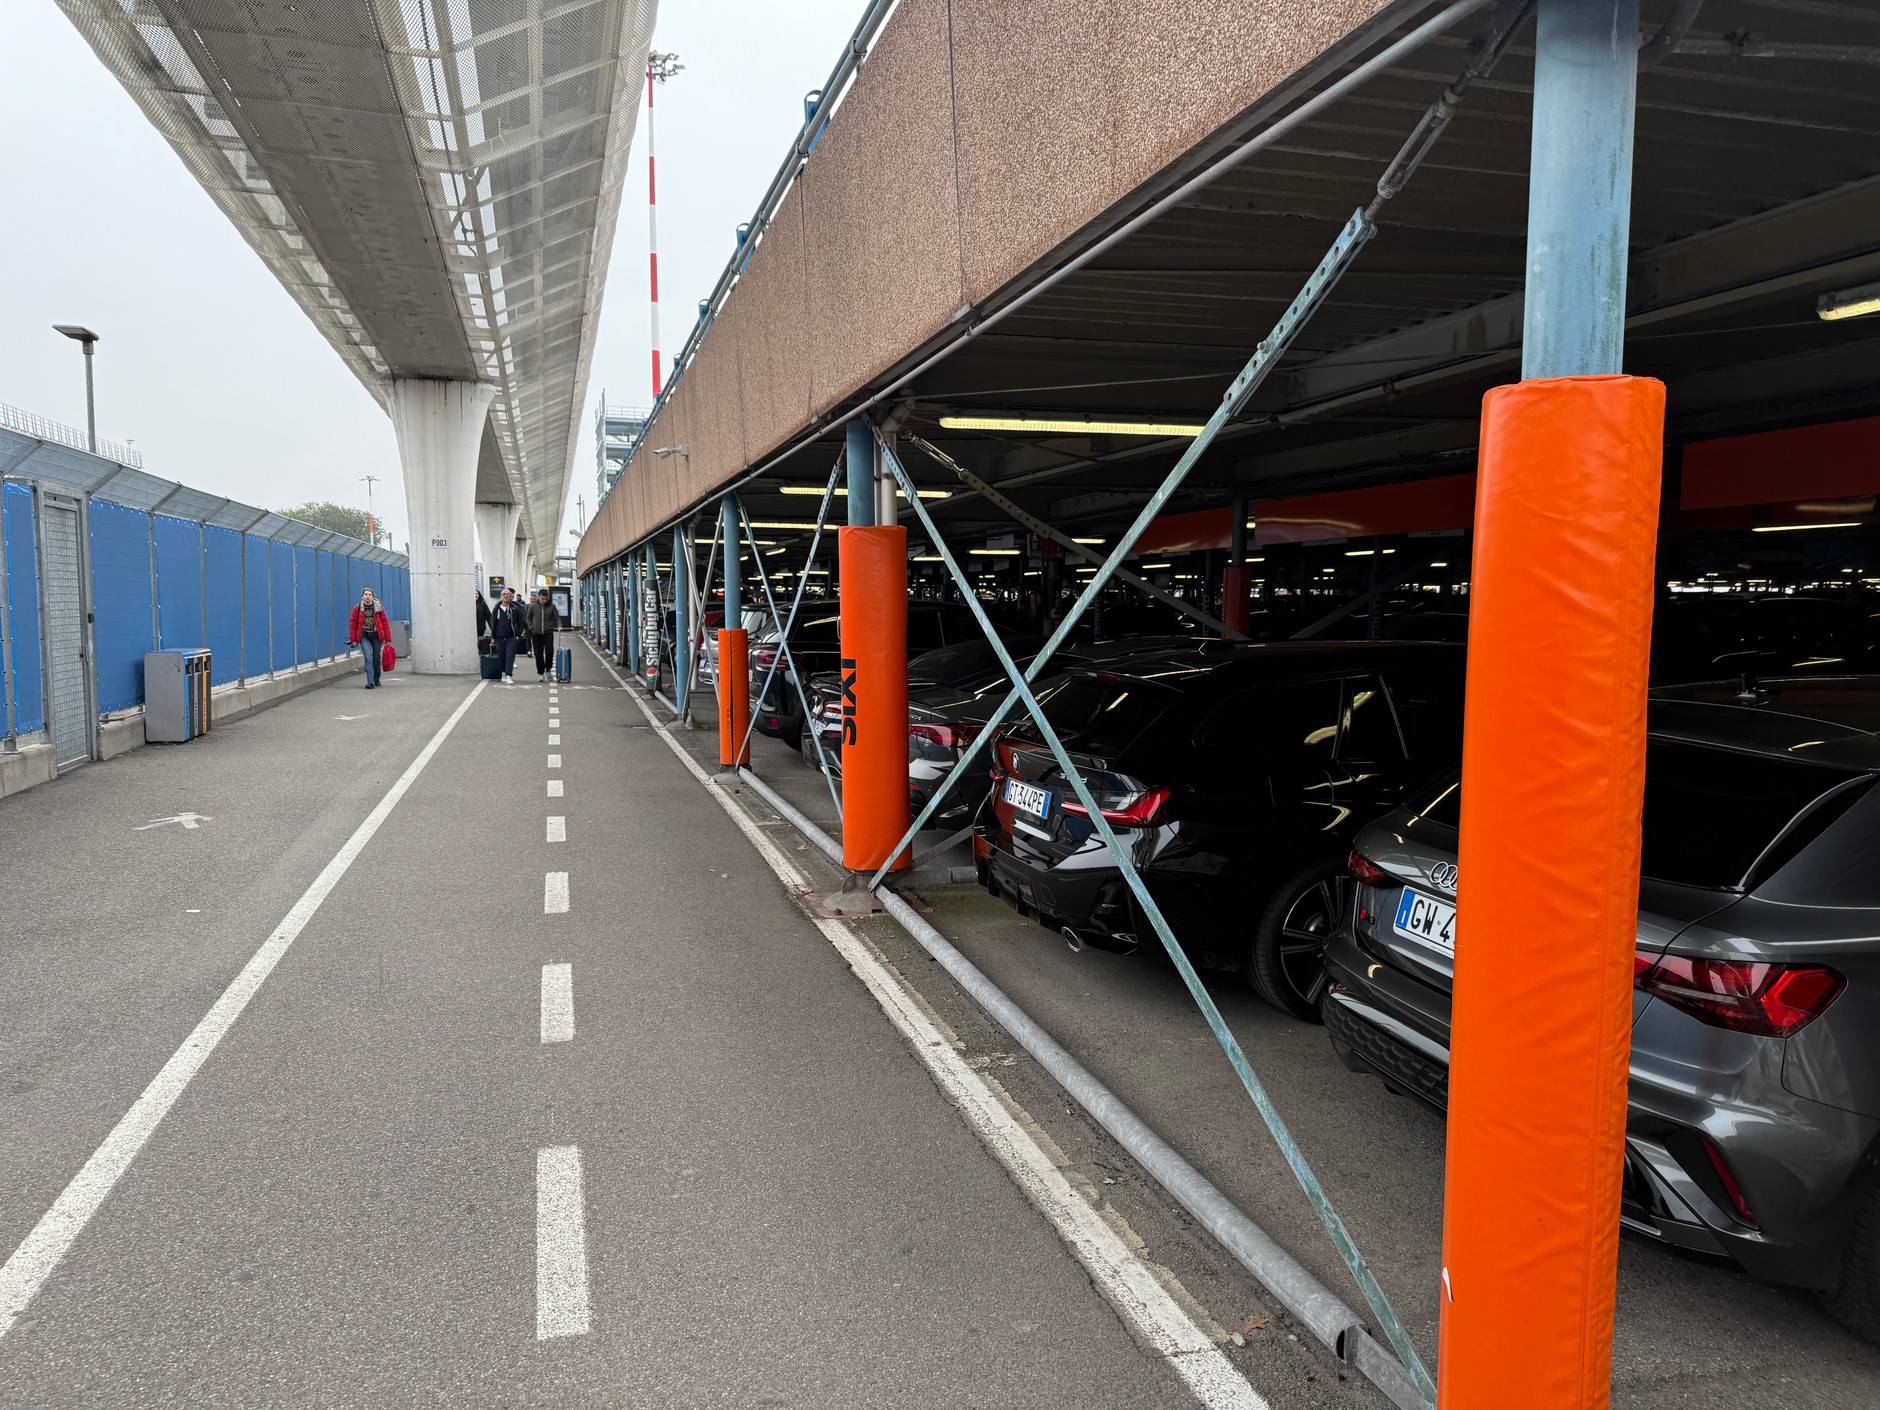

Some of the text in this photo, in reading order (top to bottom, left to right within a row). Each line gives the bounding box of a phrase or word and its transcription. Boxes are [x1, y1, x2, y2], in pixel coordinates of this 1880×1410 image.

[432, 539, 447, 547] P003
[645, 588, 659, 666] SicilybyCar
[1410, 899, 1438, 936] GW
[1439, 912, 1457, 943] 4
